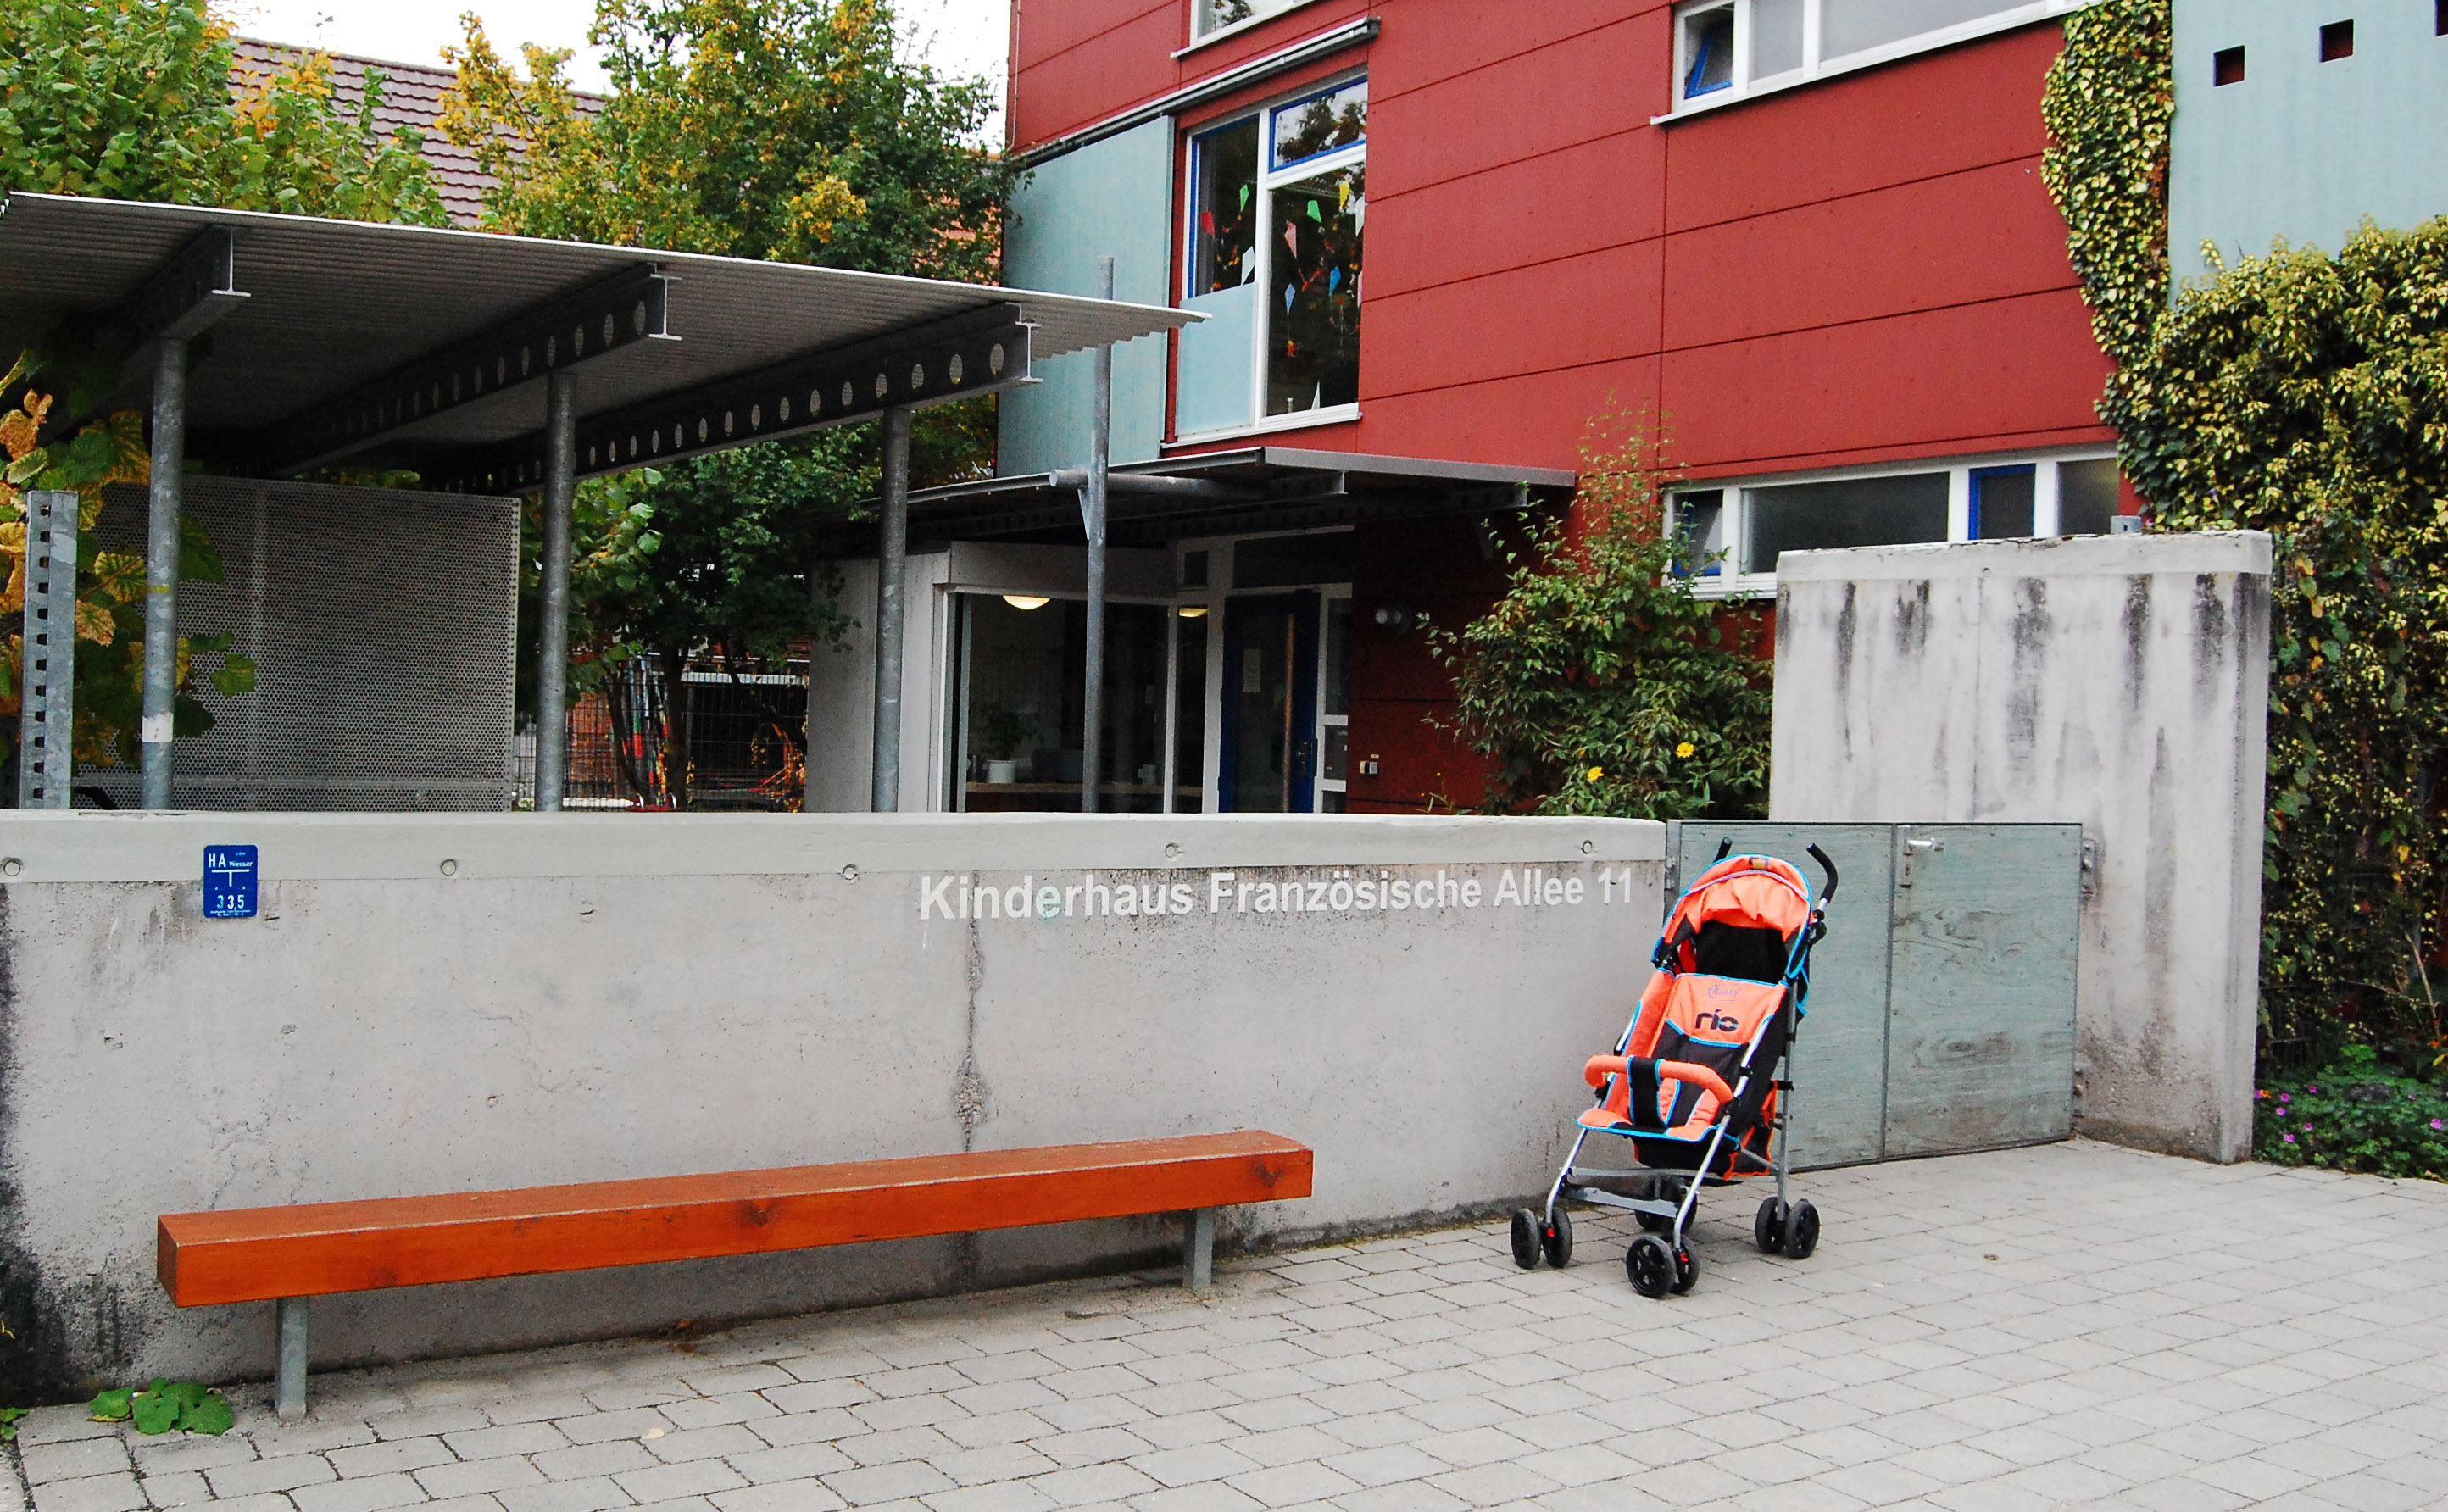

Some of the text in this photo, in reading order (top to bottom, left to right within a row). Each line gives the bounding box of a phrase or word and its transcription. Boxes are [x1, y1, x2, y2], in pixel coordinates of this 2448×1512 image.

[208, 853, 226, 868] HA
[921, 867, 1632, 920] Kinderhaus Französische Allee 11
[1695, 1009, 1739, 1032] rio
